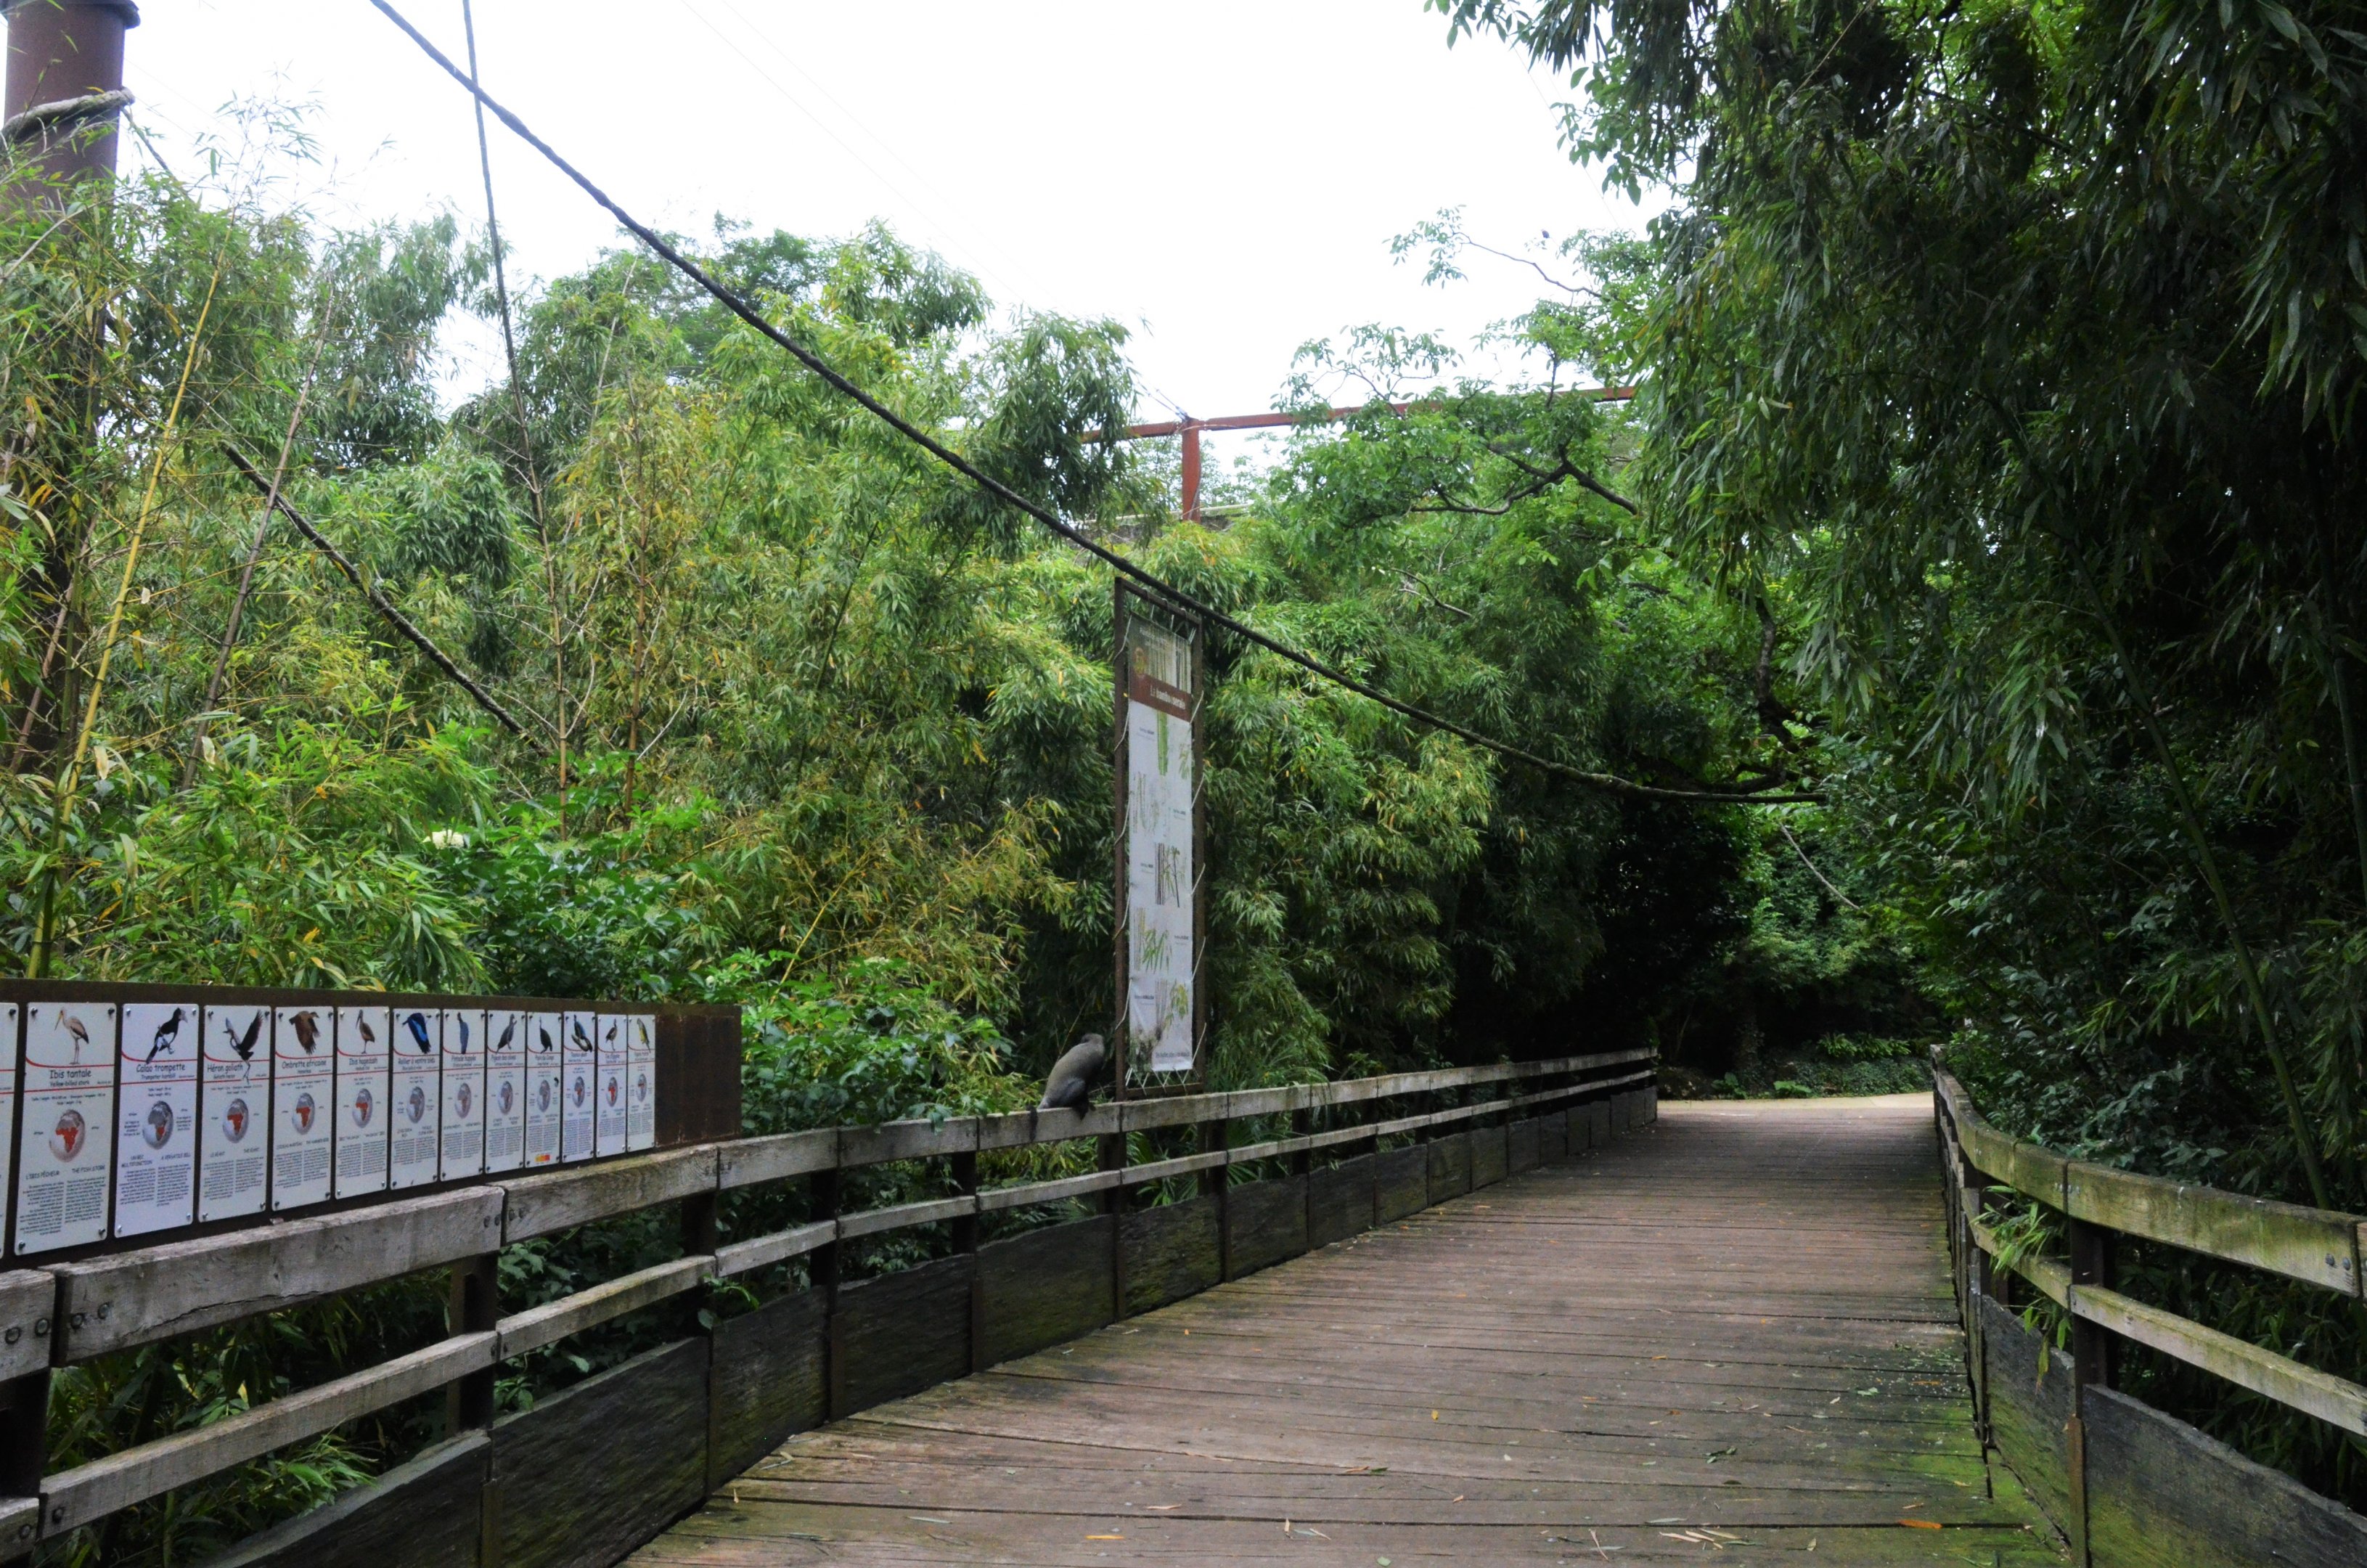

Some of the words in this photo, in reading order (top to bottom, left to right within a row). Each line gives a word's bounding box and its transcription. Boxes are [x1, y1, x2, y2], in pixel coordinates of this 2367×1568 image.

[136, 1063, 153, 1072] Calao
[155, 1063, 186, 1074] trompette
[207, 1063, 224, 1073] Héron
[225, 1063, 244, 1074] goliath
[282, 1061, 306, 1069] Ombrette
[49, 1069, 65, 1079] Ibis
[67, 1069, 91, 1078] tantale
